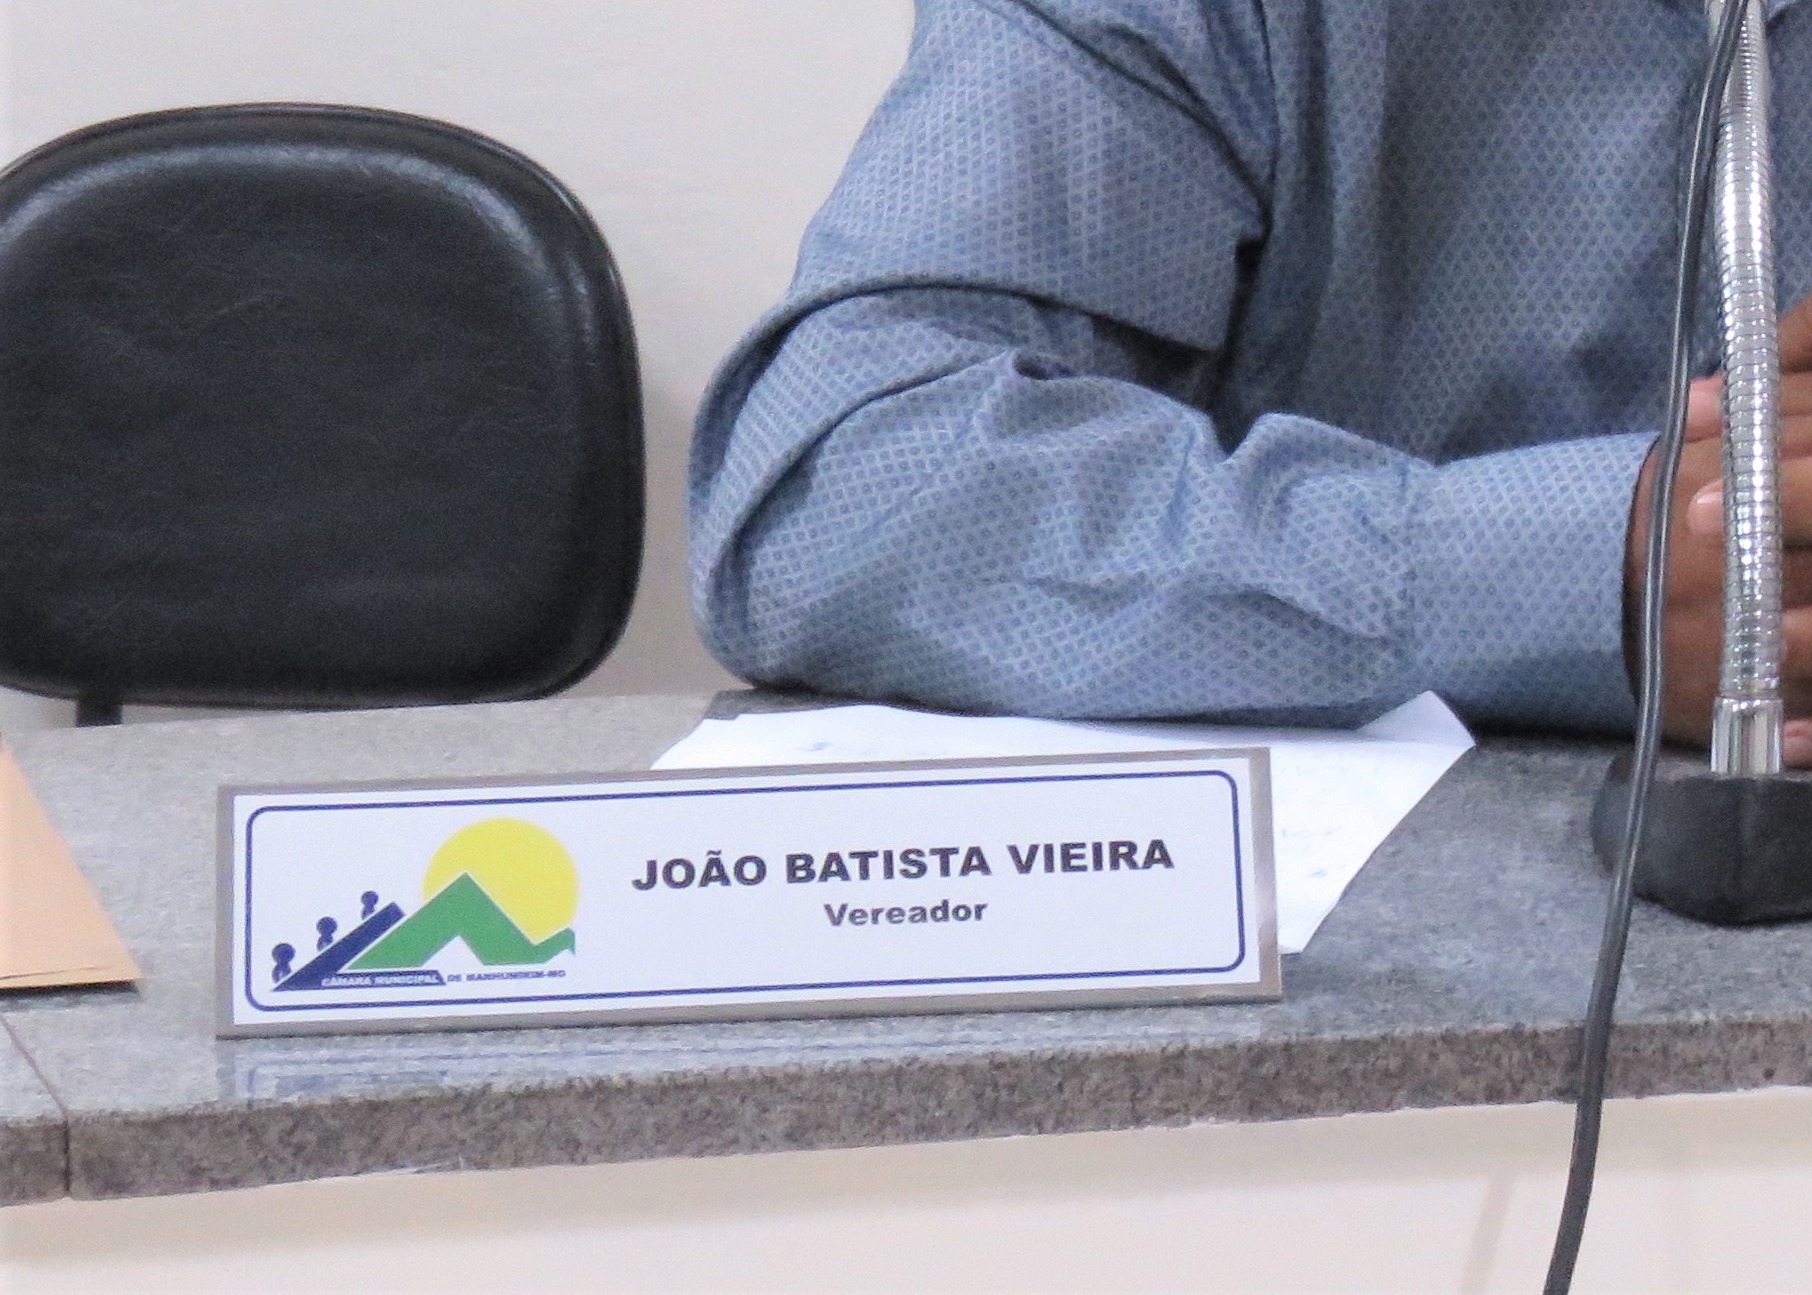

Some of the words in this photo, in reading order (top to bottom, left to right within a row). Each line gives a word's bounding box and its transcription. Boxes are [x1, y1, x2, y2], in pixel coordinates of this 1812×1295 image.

[632, 850, 767, 891] JOÃO
[785, 847, 992, 884] BATISTA
[1007, 839, 1174, 874] VIEIRA
[824, 899, 988, 926] Vereador
[447, 973, 462, 982] DE
